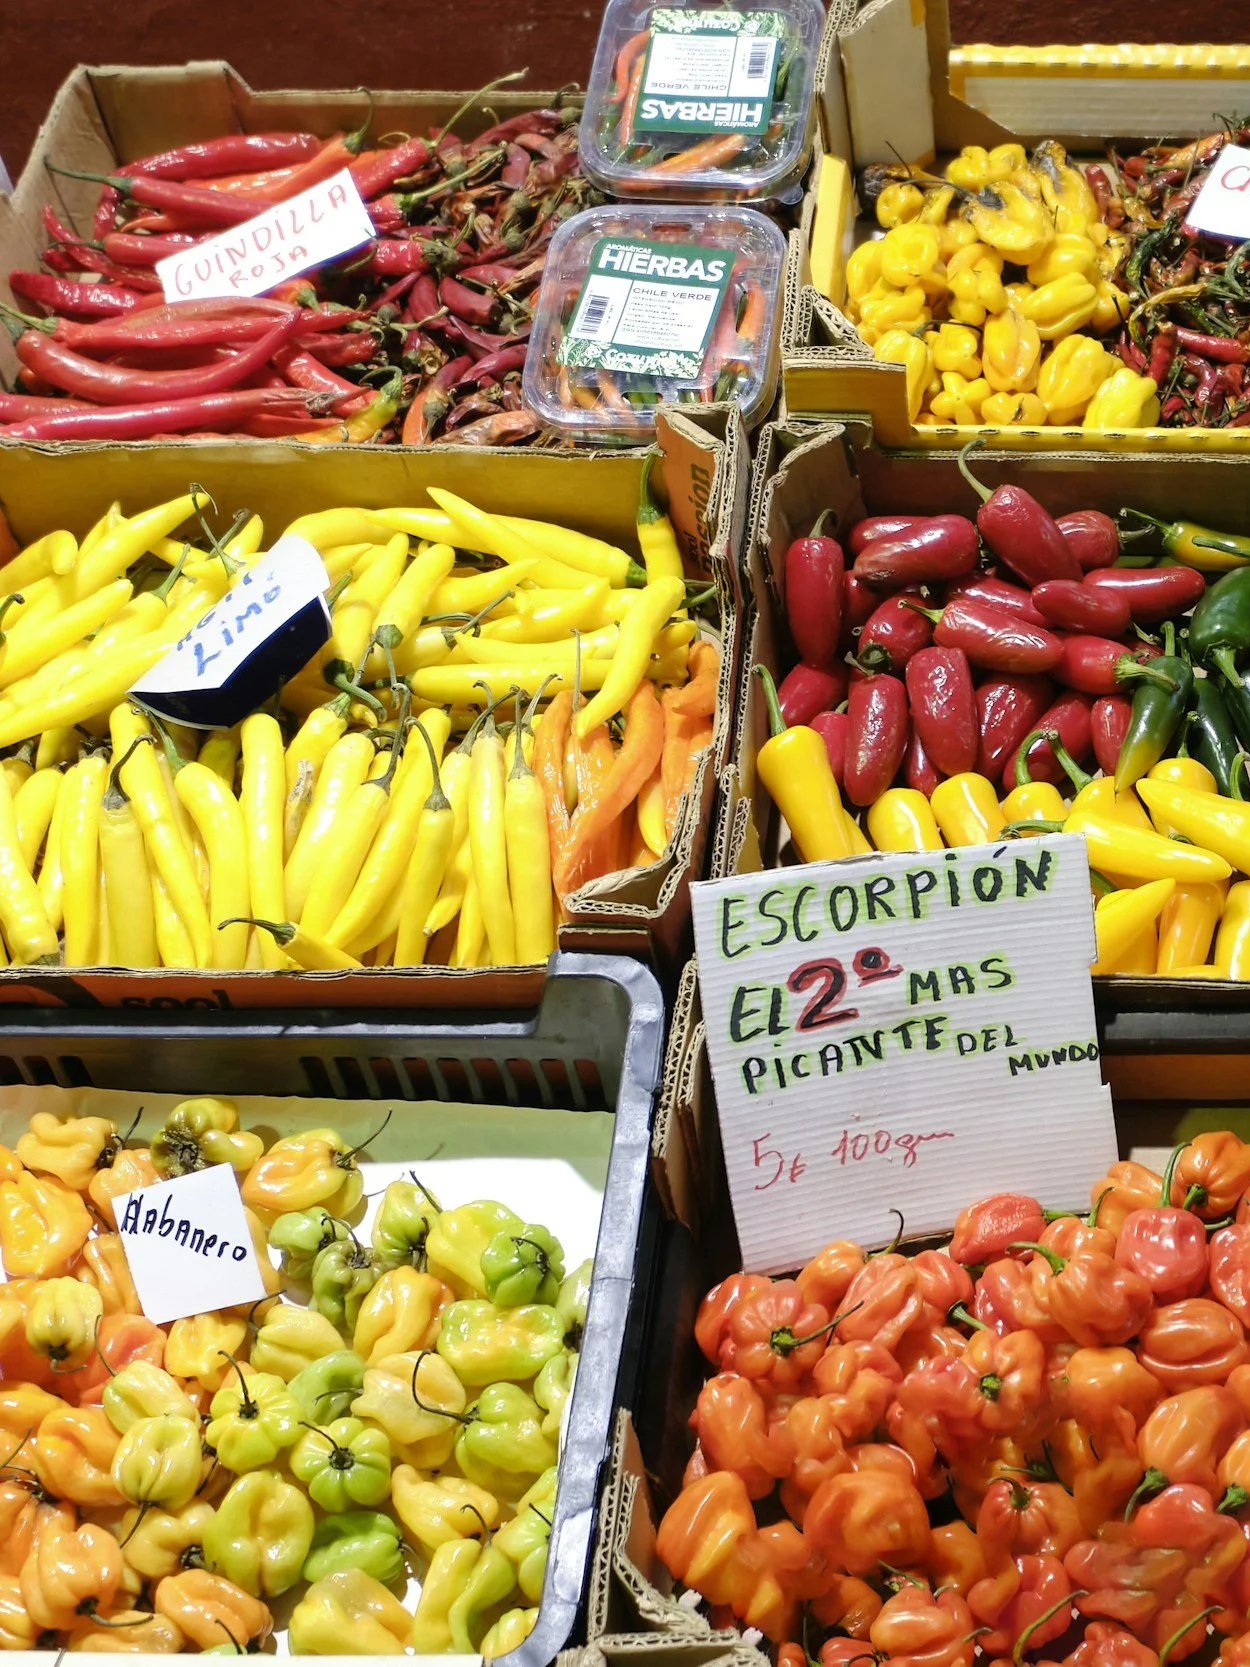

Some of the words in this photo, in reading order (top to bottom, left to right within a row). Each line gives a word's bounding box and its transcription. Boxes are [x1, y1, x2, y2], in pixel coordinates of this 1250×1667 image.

[640, 99, 764, 122] HIERBAS
[174, 183, 347, 296] GUINDILLA
[228, 244, 308, 289] ROJA
[597, 249, 727, 282] HIERBAS
[632, 287, 669, 297] CHILE
[672, 292, 713, 302] VERDE
[720, 846, 1053, 959] ESCORPIÓN
[729, 985, 790, 1043] EL
[908, 957, 1013, 1006] MAS
[741, 1016, 950, 1095] PICANTE
[957, 1024, 1019, 1057] DEL
[1007, 1042, 1100, 1077] MUNDO
